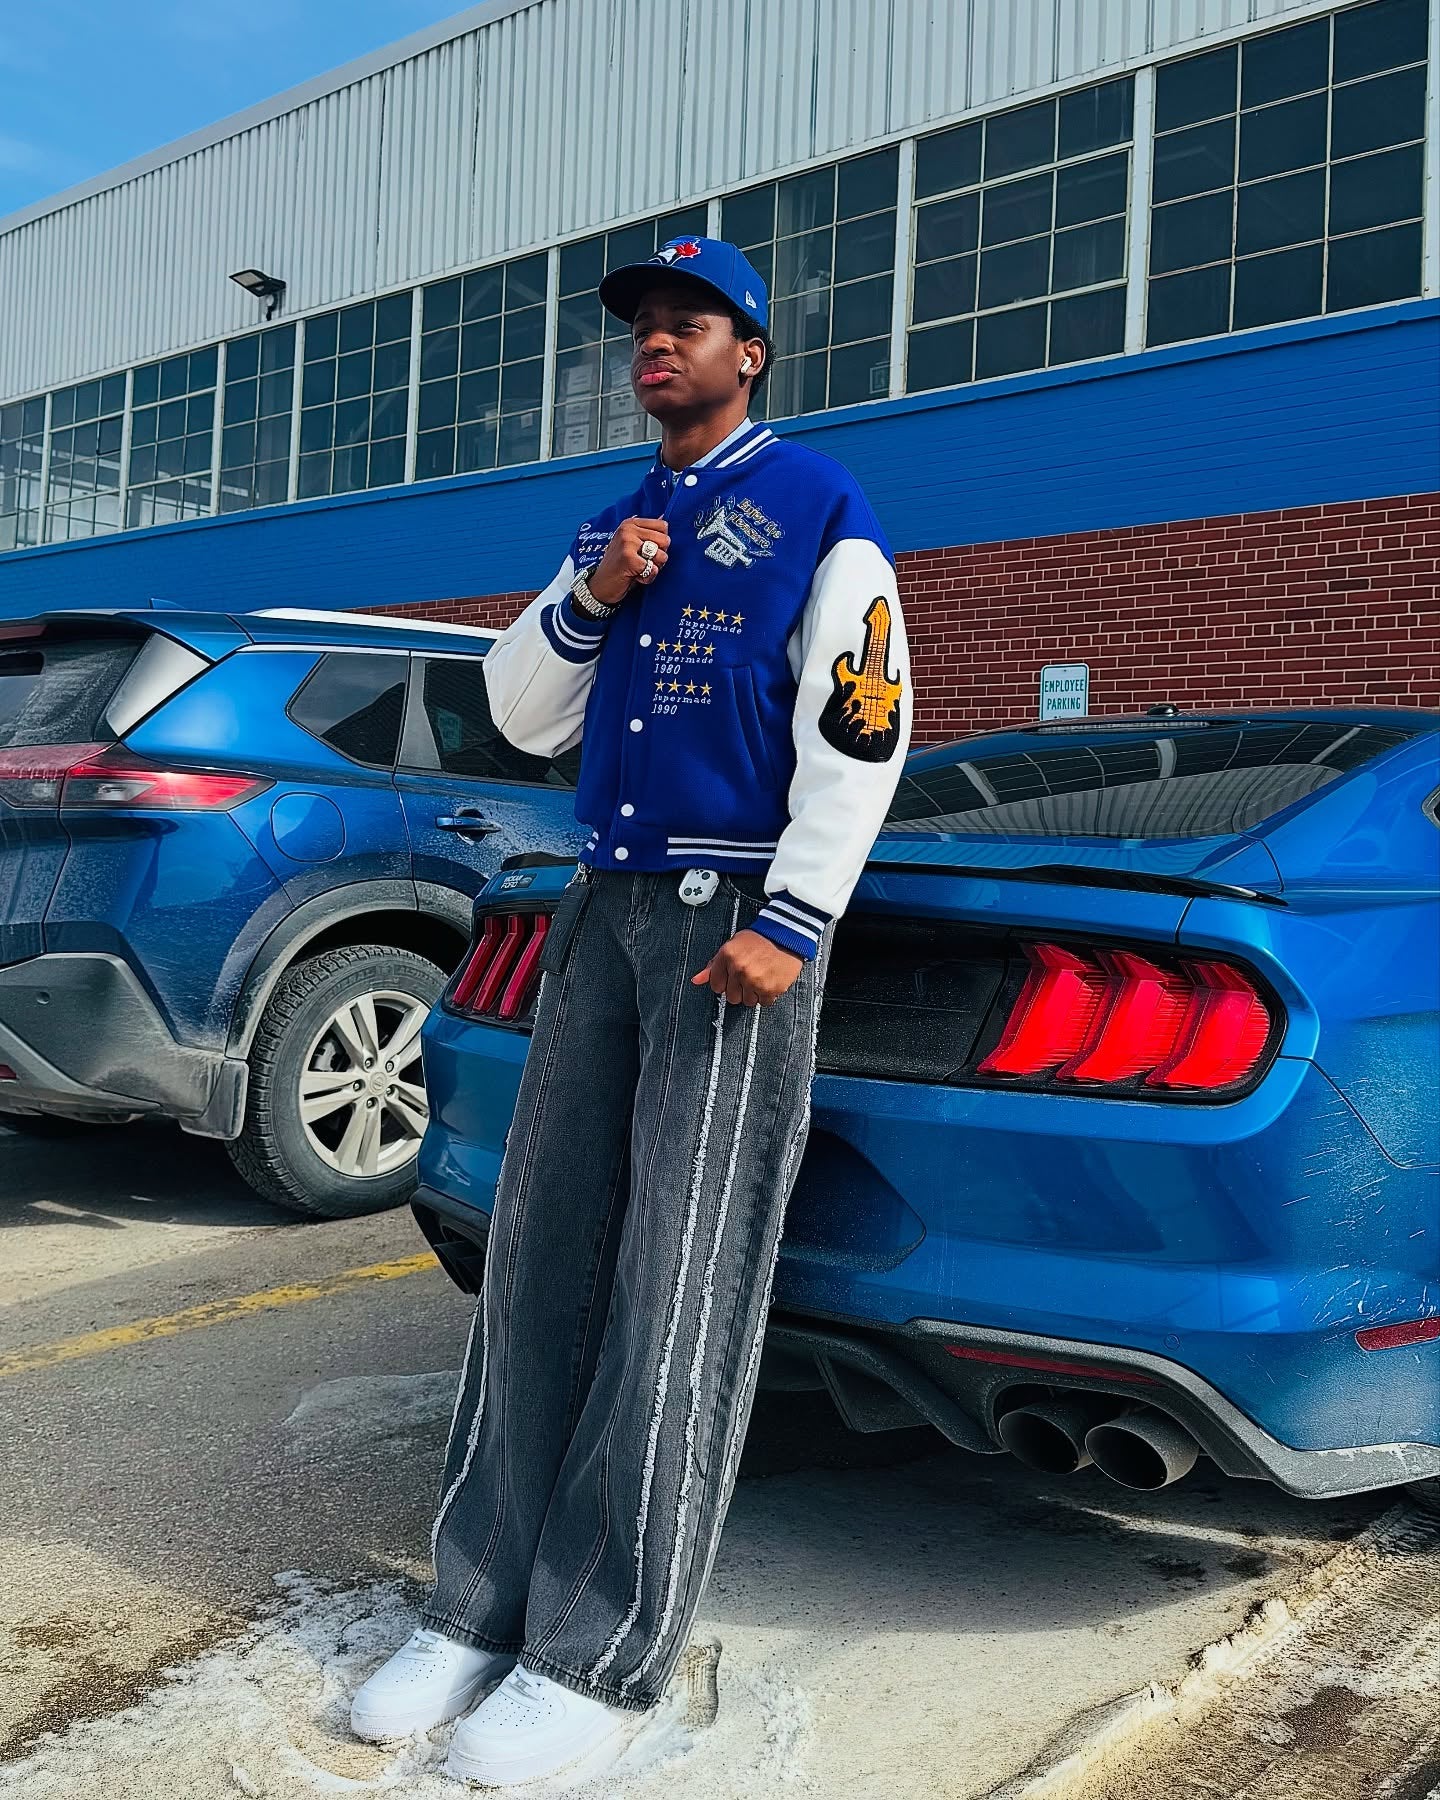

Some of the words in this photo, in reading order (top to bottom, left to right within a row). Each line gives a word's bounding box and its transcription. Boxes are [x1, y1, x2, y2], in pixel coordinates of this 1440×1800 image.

[679, 619, 742, 634] Supermade
[677, 628, 706, 640] 1970
[655, 653, 713, 663] Supermade
[653, 663, 681, 675] 1980
[1044, 680, 1084, 692] EMPLOYEE
[653, 694, 712, 704] Supermade
[1047, 698, 1080, 710] PARKING
[651, 704, 678, 715] 1990
